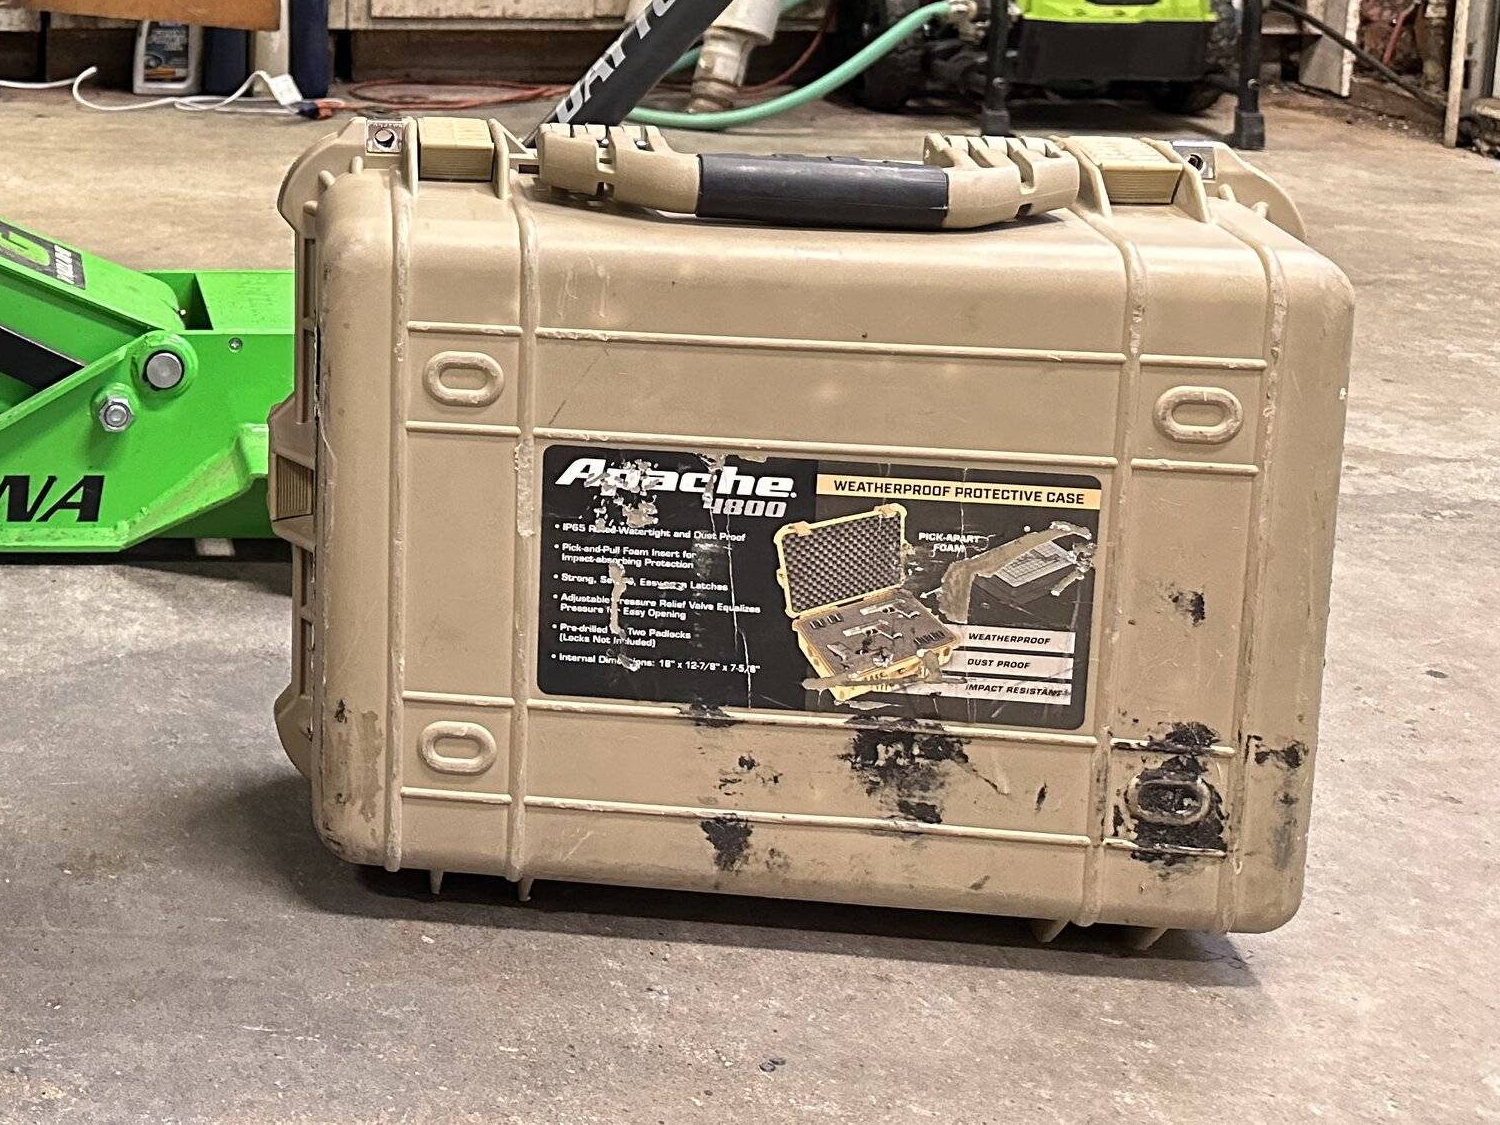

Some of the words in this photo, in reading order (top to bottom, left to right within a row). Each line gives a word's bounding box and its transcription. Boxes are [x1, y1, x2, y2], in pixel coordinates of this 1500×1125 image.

[834, 479, 950, 497] WEATHERPROOF
[954, 486, 1043, 502] PROTECTIVE
[1046, 491, 1085, 505] CASE
[703, 498, 787, 518] 4800
[562, 523, 586, 532] IP65
[673, 530, 691, 539] and
[693, 530, 718, 540] Dust
[719, 532, 746, 542] Proof
[562, 543, 620, 554] Pick-and-Pull
[622, 546, 649, 556] Foam
[651, 548, 680, 558] Insert
[682, 550, 697, 559] for
[933, 543, 966, 554] FOAM
[561, 553, 642, 567] Impact-absorbing
[644, 558, 694, 569] Protection
[561, 573, 597, 584] Strong,
[690, 581, 728, 591] Latches
[561, 593, 610, 604] Adjustable
[612, 597, 657, 607] ressure
[659, 599, 687, 609] Relief
[688, 601, 714, 610] Valve
[716, 603, 761, 613] Equalizes
[560, 603, 604, 613] Pressure
[623, 607, 646, 618] Easy
[647, 609, 686, 620] Opening
[559, 633, 590, 644] (Locks
[592, 635, 611, 644] Not
[560, 623, 608, 634] Pre-drilled
[627, 627, 646, 636] Two
[649, 629, 691, 639] Padlocks
[968, 632, 1051, 645] WEATHERPROOF
[559, 653, 596, 663] Internal
[967, 658, 994, 668] DUST
[997, 660, 1031, 670] PROOF
[965, 683, 1003, 694] IMPACT
